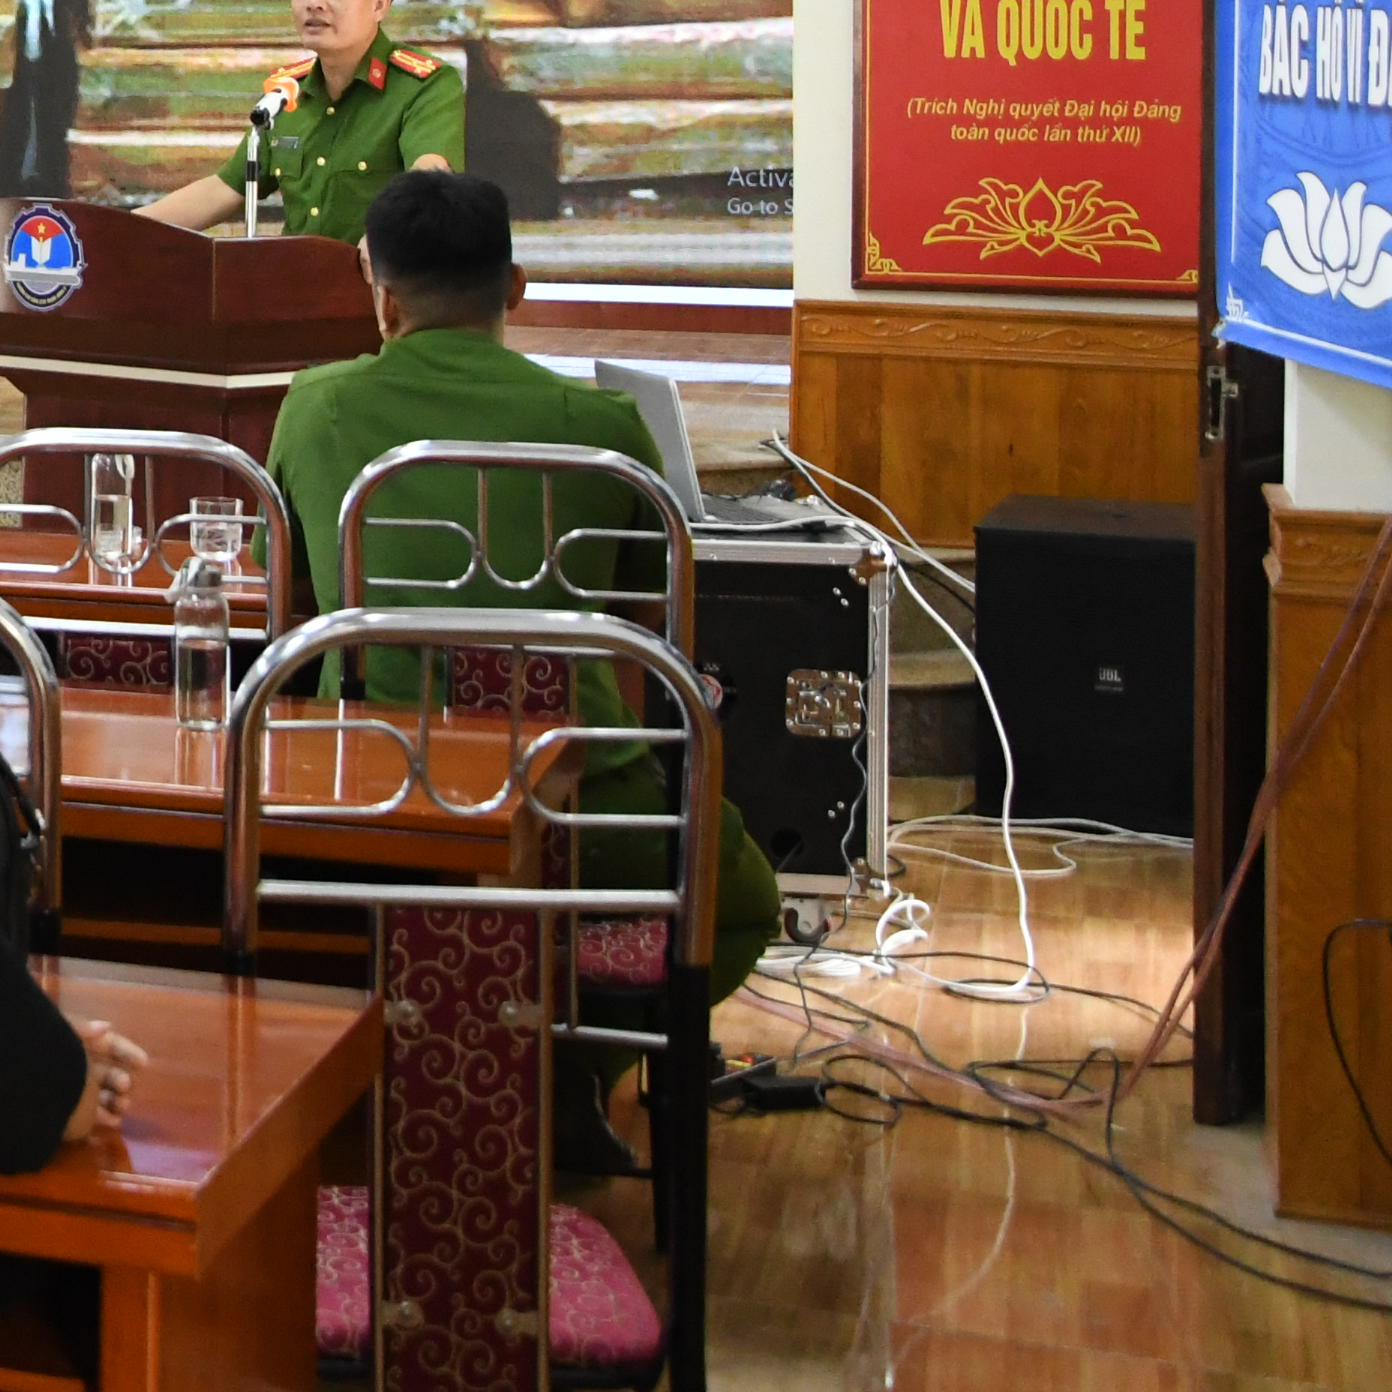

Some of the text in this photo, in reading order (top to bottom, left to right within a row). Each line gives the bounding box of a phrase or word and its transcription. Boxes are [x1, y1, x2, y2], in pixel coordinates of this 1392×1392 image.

[907, 97, 1181, 123] (Trích Nghị quyết Đại hội Đảng
[951, 121, 1141, 146] toàn quốc lần thứ XII)
[727, 197, 753, 215] Go
[760, 199, 779, 215] to
